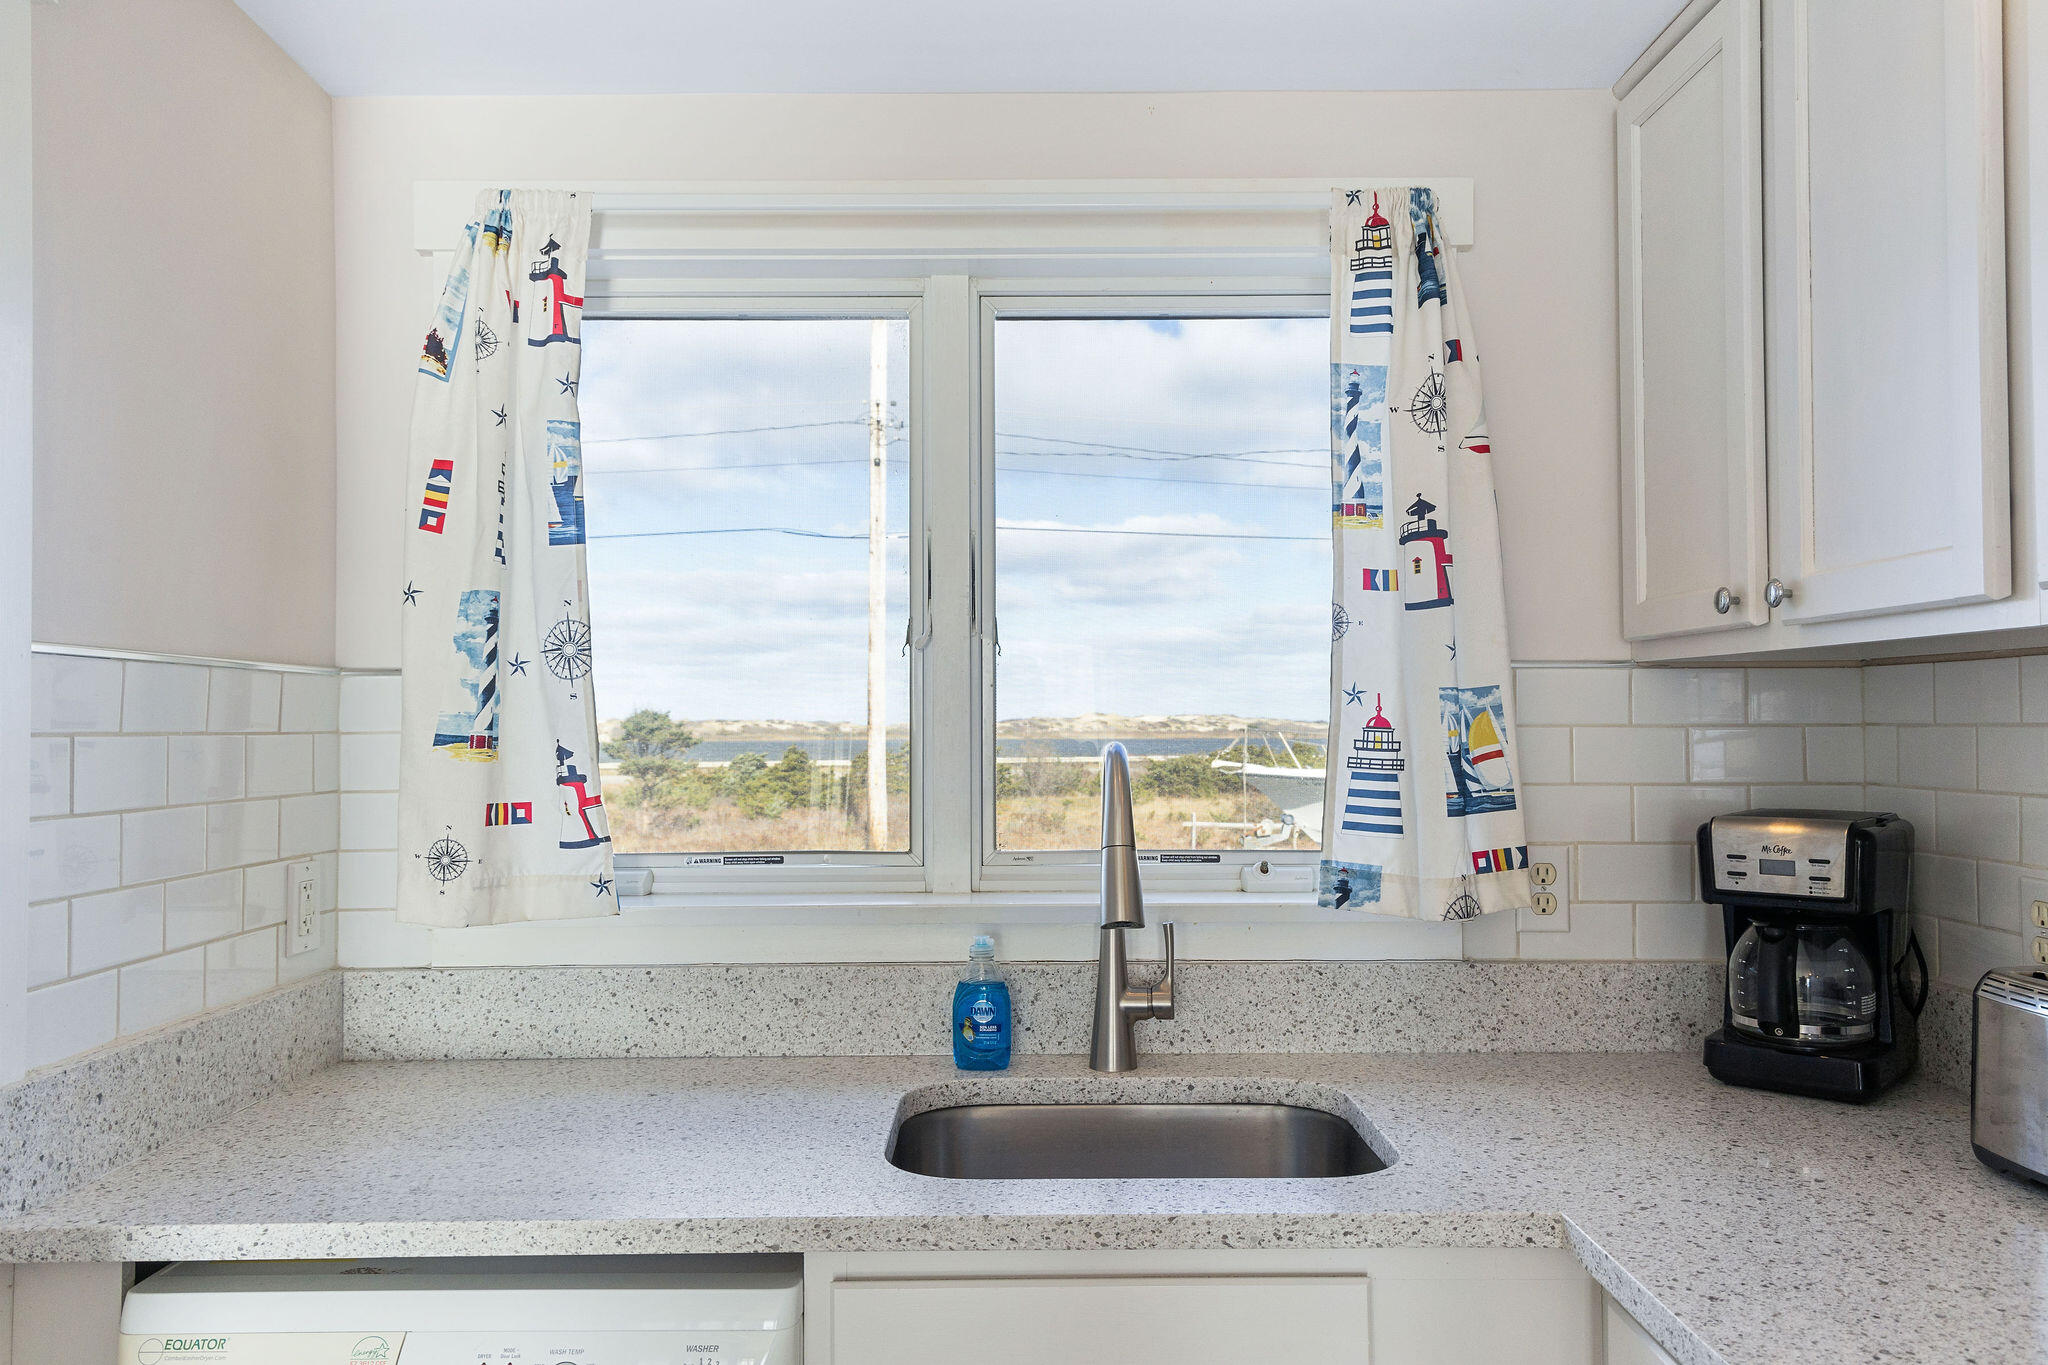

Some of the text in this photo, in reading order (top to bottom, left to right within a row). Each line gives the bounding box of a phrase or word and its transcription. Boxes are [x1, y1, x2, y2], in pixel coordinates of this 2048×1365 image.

[1437, 445, 1445, 453] S
[1773, 844, 1791, 856] Coffee
[970, 1006, 996, 1017] DAWN
[164, 1338, 226, 1351] EQUATOR
[686, 1344, 720, 1352] WASHER
